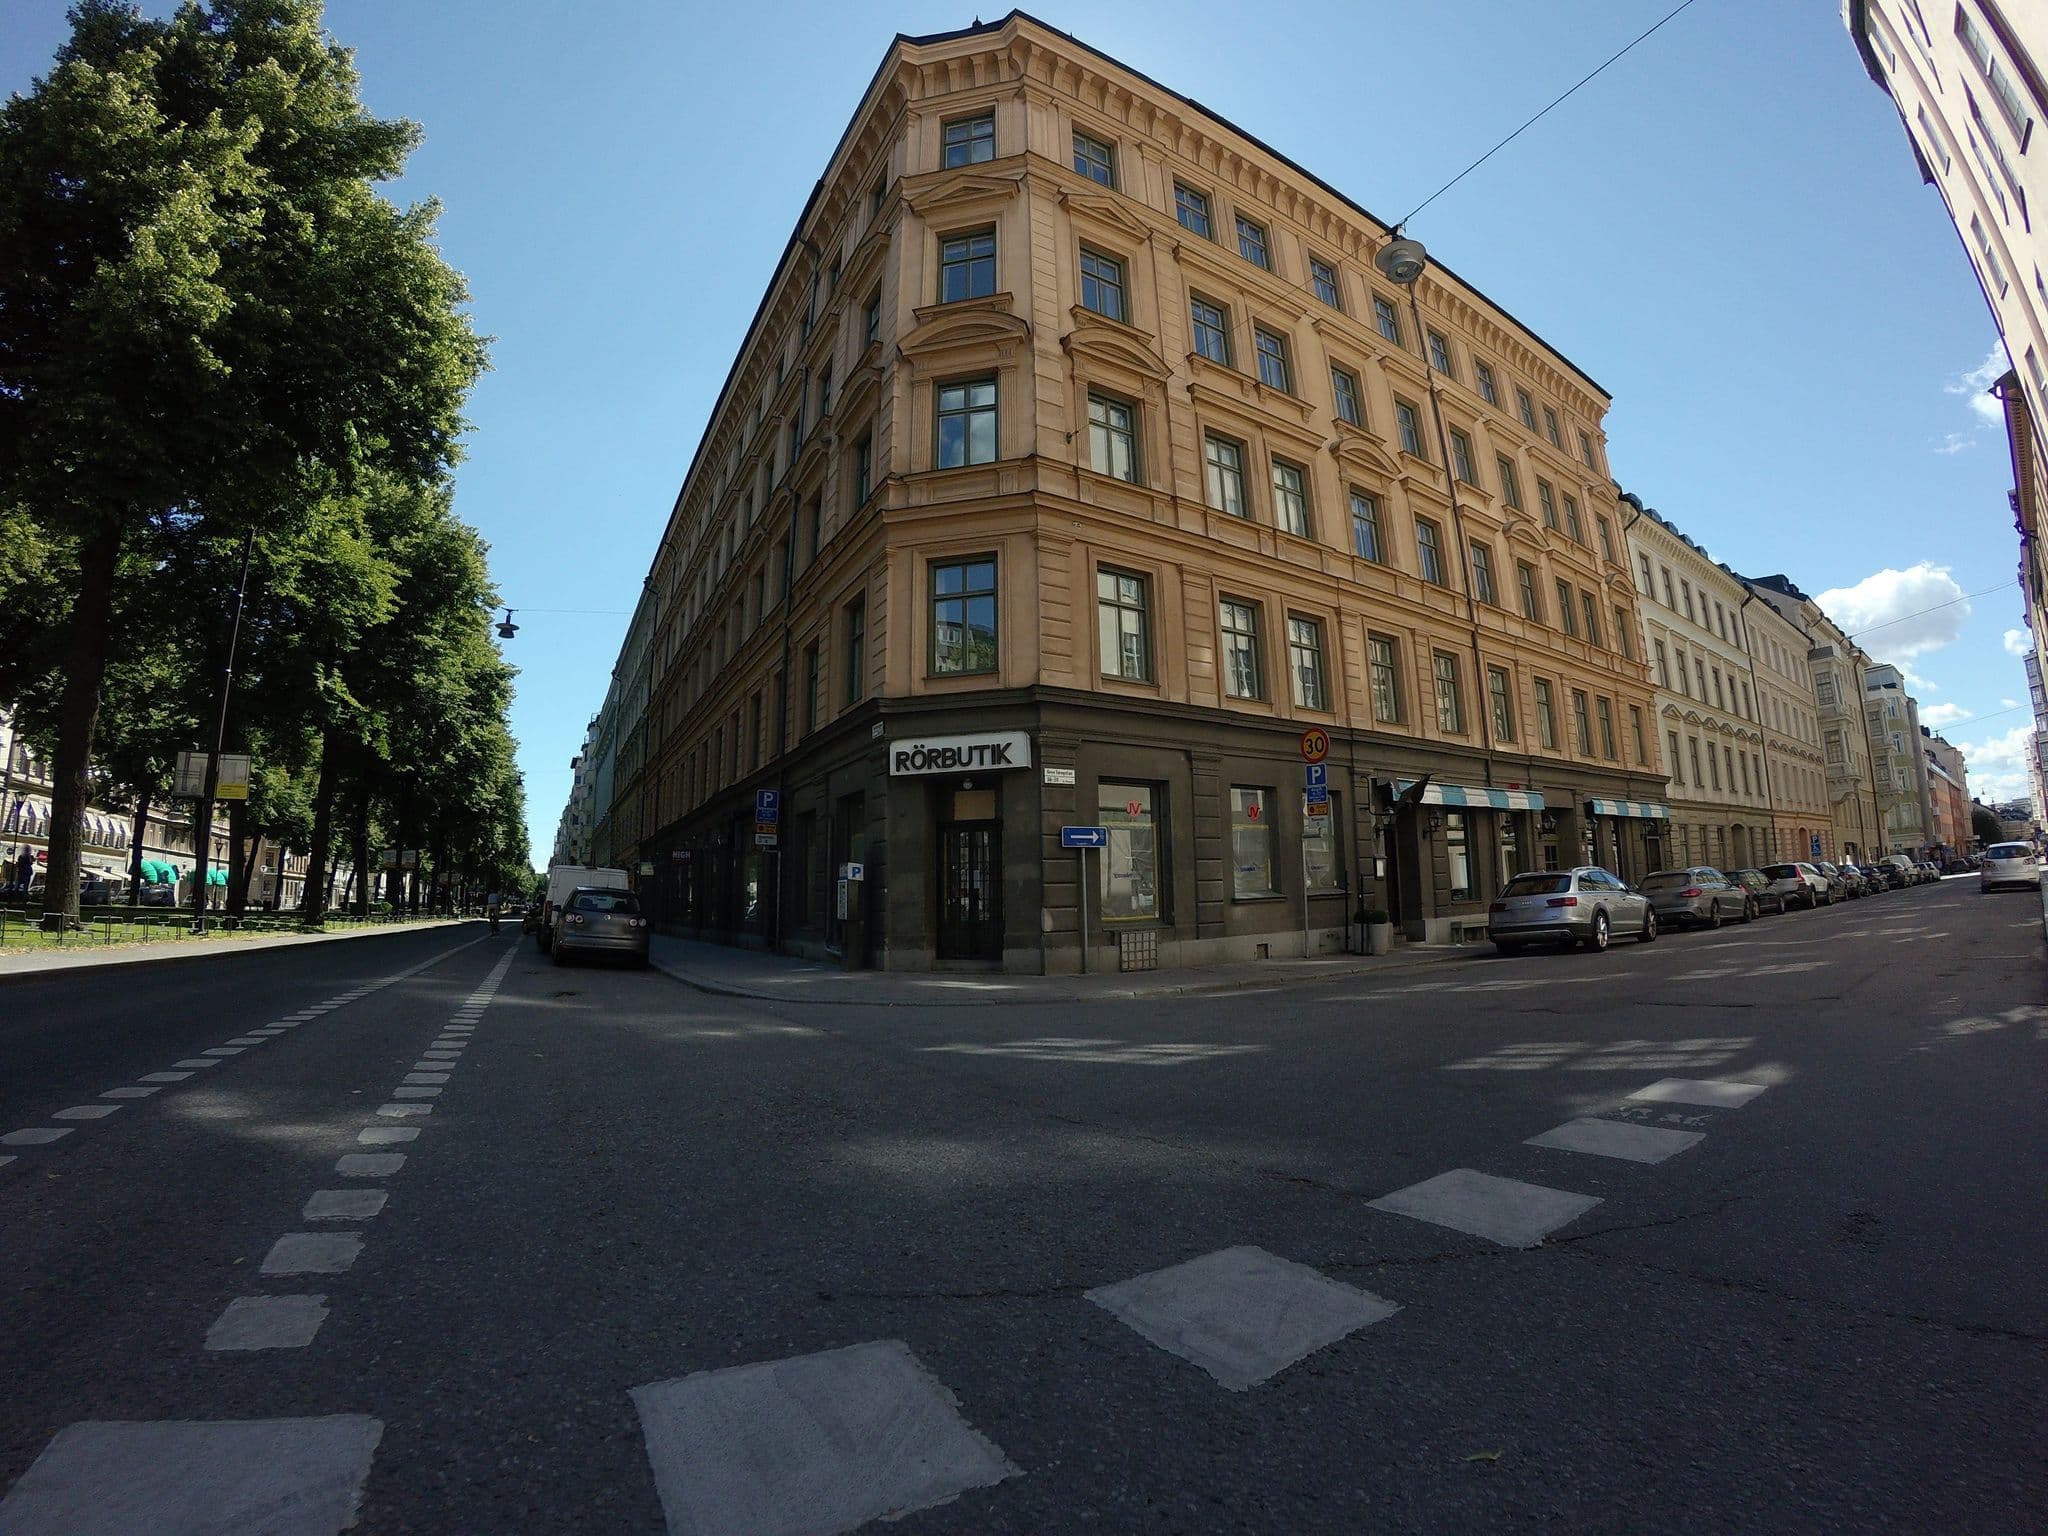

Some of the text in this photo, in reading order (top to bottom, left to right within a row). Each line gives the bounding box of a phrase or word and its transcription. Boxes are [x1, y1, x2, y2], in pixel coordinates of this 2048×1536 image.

[1306, 736, 1325, 755] 30
[895, 742, 1013, 772] RÖRBUTIK
[1311, 766, 1322, 785] P
[763, 791, 774, 807] P
[852, 866, 861, 878] P
